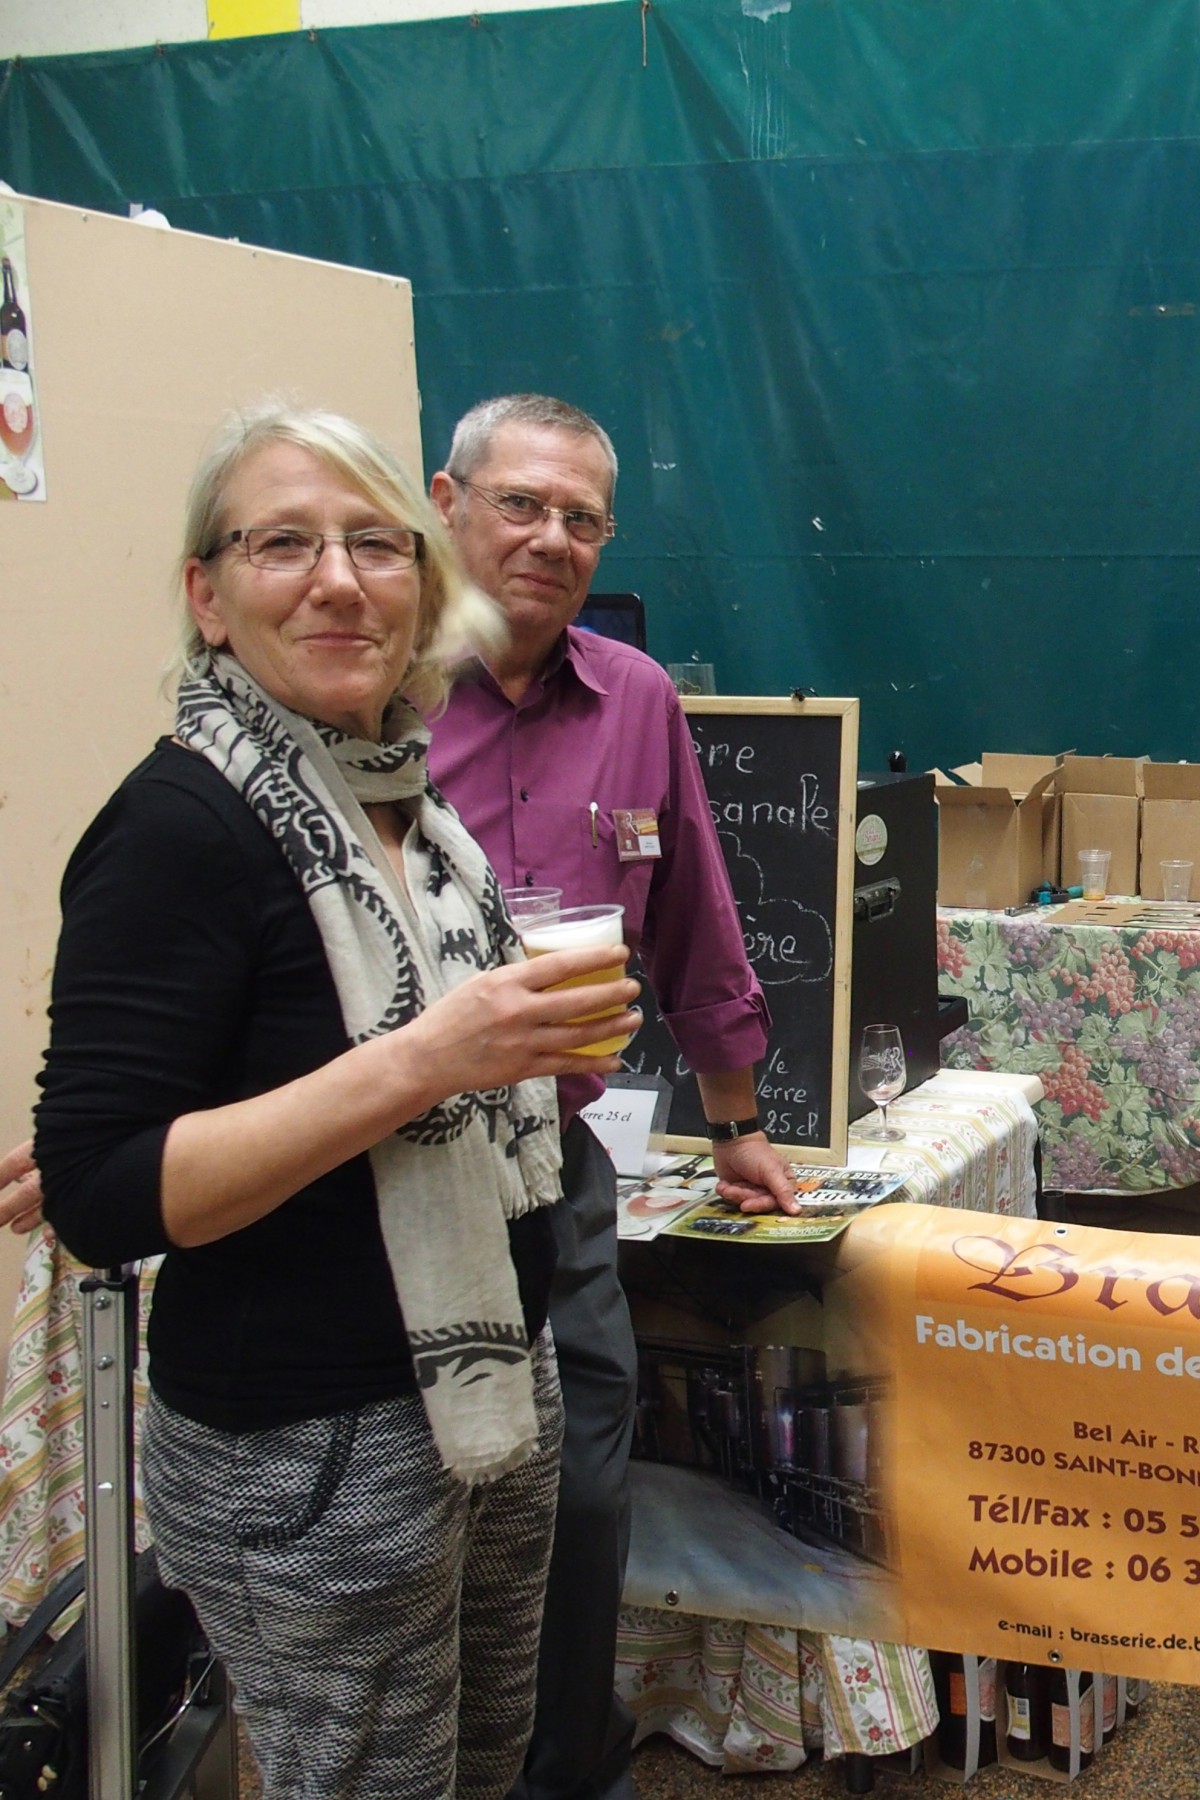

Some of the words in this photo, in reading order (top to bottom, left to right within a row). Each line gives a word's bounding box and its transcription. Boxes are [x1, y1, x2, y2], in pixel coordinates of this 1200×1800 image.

[708, 773, 832, 832] sanale
[768, 1047, 791, 1074] le
[606, 1110, 620, 1121] 25
[621, 1112, 632, 1122] cl
[764, 1109, 792, 1134] 25
[793, 1167, 835, 1179] SERIE
[915, 1315, 1141, 1371] Fabrication
[1073, 1421, 1112, 1443] Bel
[1121, 1429, 1157, 1449] Air
[967, 1440, 1046, 1467] 87300
[967, 1494, 1091, 1529] Tél/Fax
[1123, 1508, 1168, 1534] 05
[968, 1546, 1093, 1580] Mobile
[1127, 1553, 1172, 1582] 06
[998, 1617, 1052, 1640] e-mail
